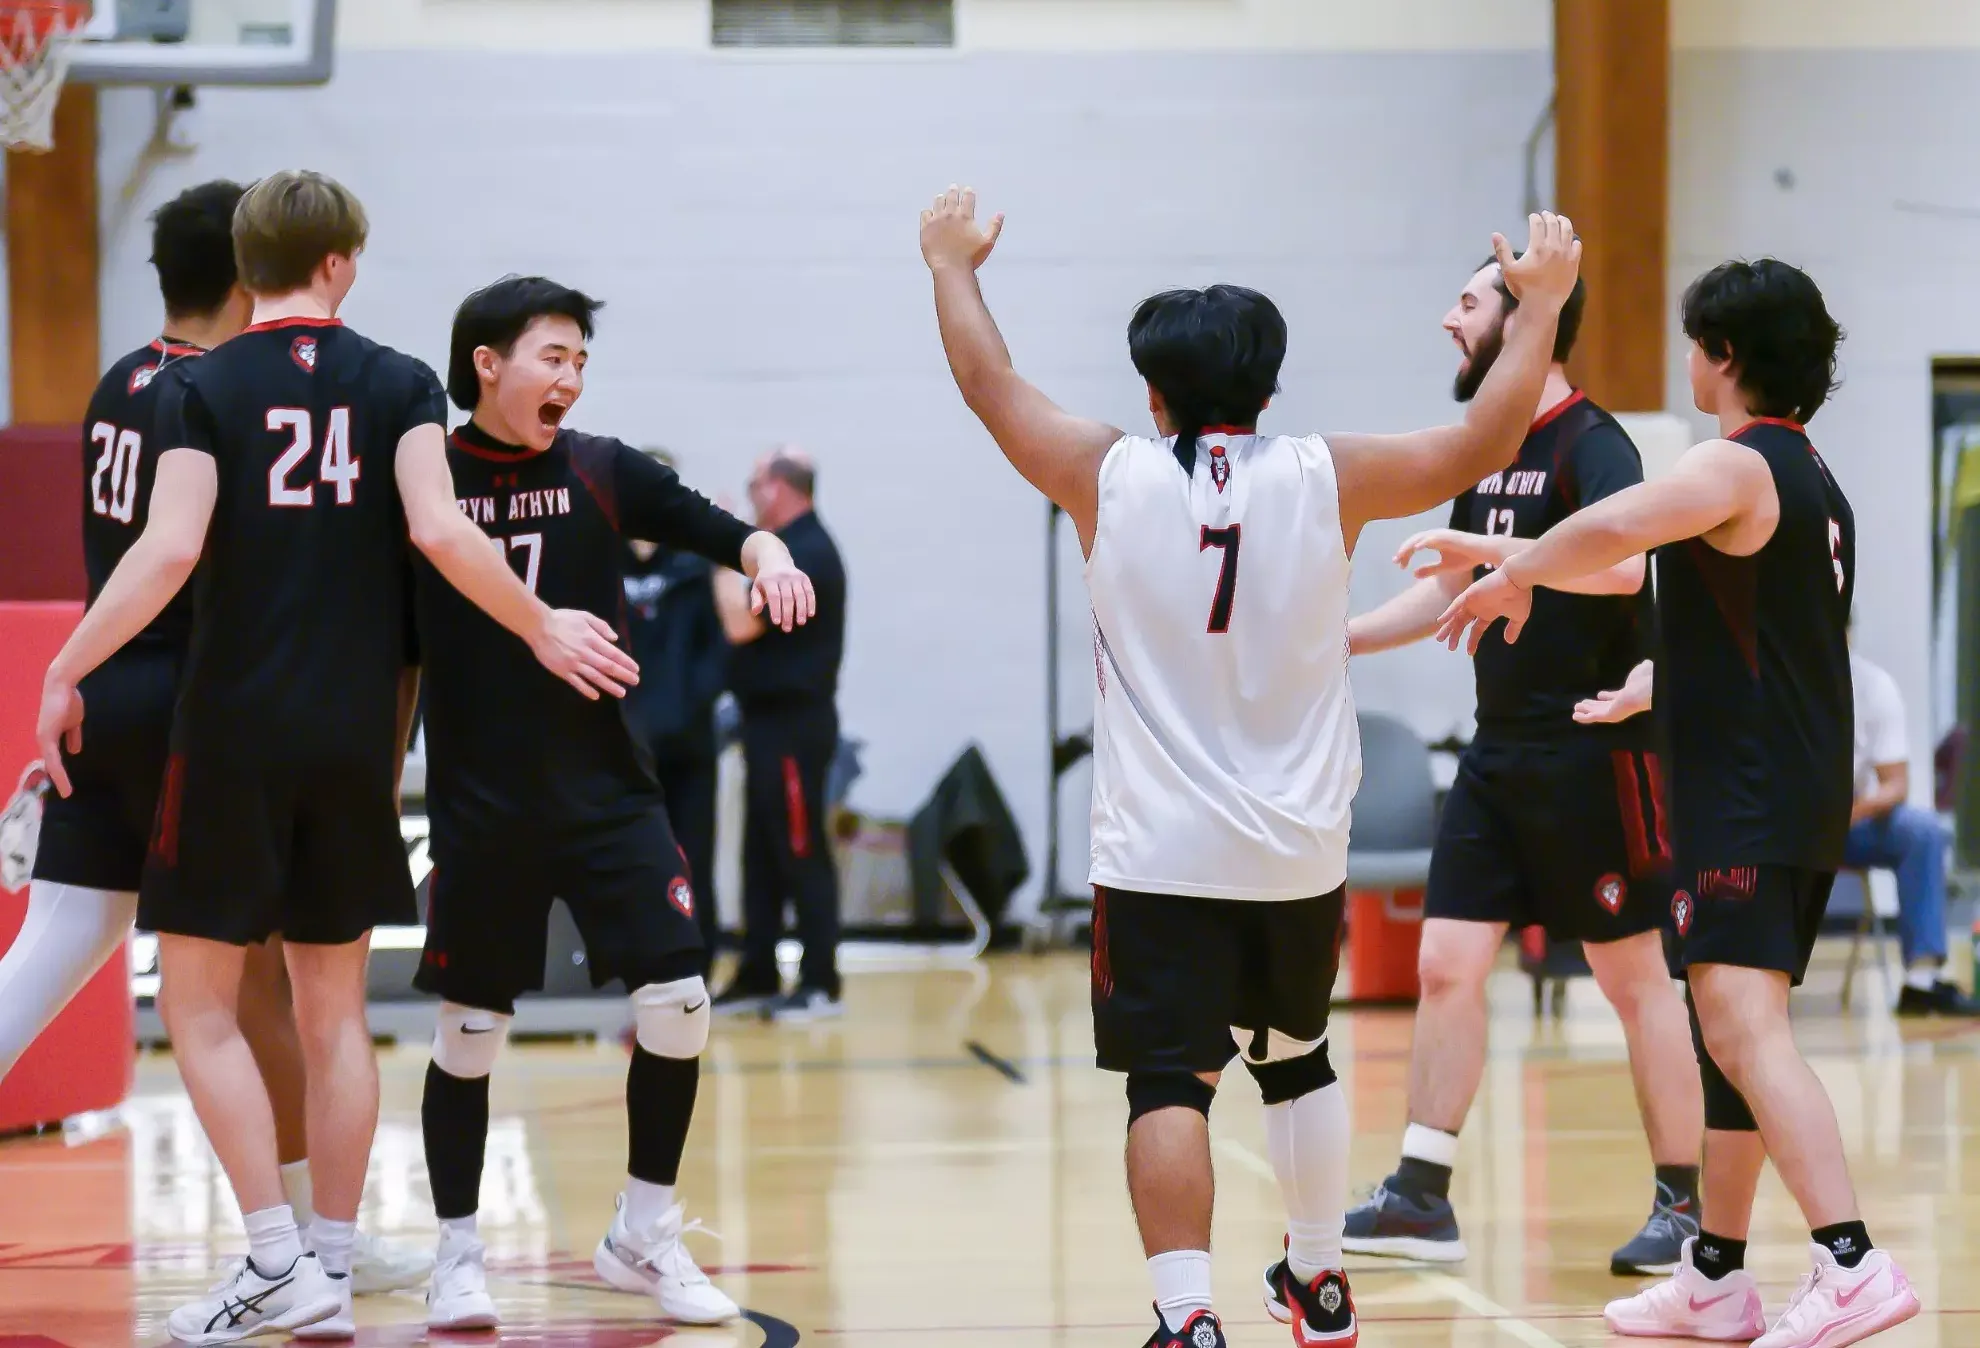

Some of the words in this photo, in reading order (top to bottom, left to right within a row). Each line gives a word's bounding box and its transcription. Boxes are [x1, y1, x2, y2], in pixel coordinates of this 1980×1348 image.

[91, 421, 143, 525] 20
[265, 406, 360, 506] 24
[508, 487, 571, 521] ATHYN
[489, 532, 542, 596] 7
[1199, 523, 1241, 634] 7
